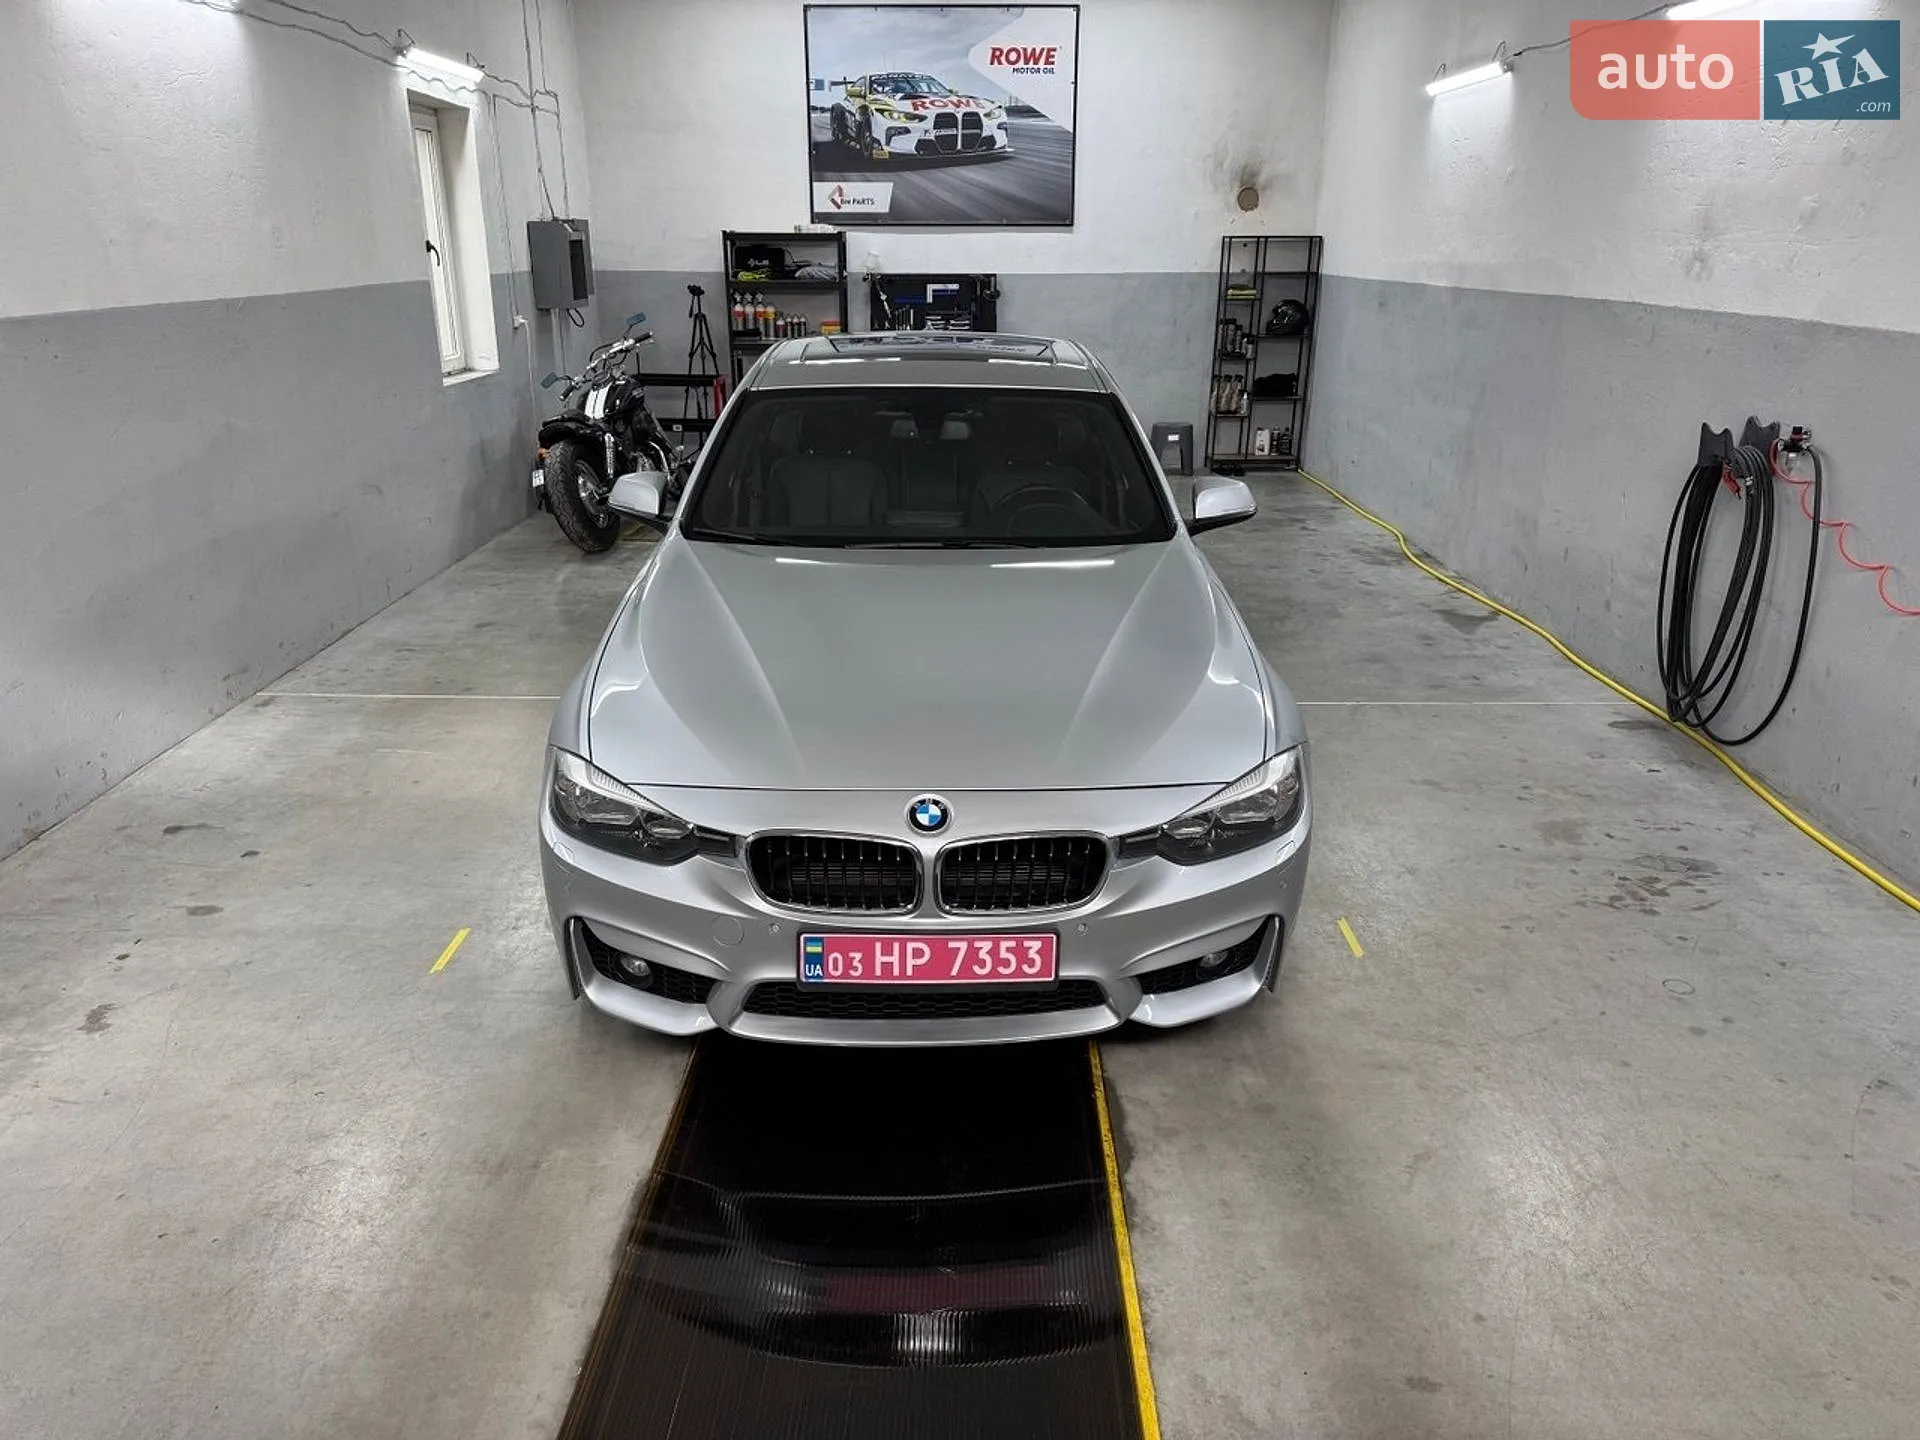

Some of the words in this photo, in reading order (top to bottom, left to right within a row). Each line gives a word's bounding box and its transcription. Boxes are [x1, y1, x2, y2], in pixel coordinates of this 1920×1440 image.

[989, 46, 1057, 66] ROWE
[1012, 67, 1041, 75] MOTOR
[1042, 67, 1055, 75] OIL
[827, 951, 864, 977] 03
[874, 941, 931, 976] HP
[948, 940, 1042, 976] 7353
[805, 963, 824, 977] UA
